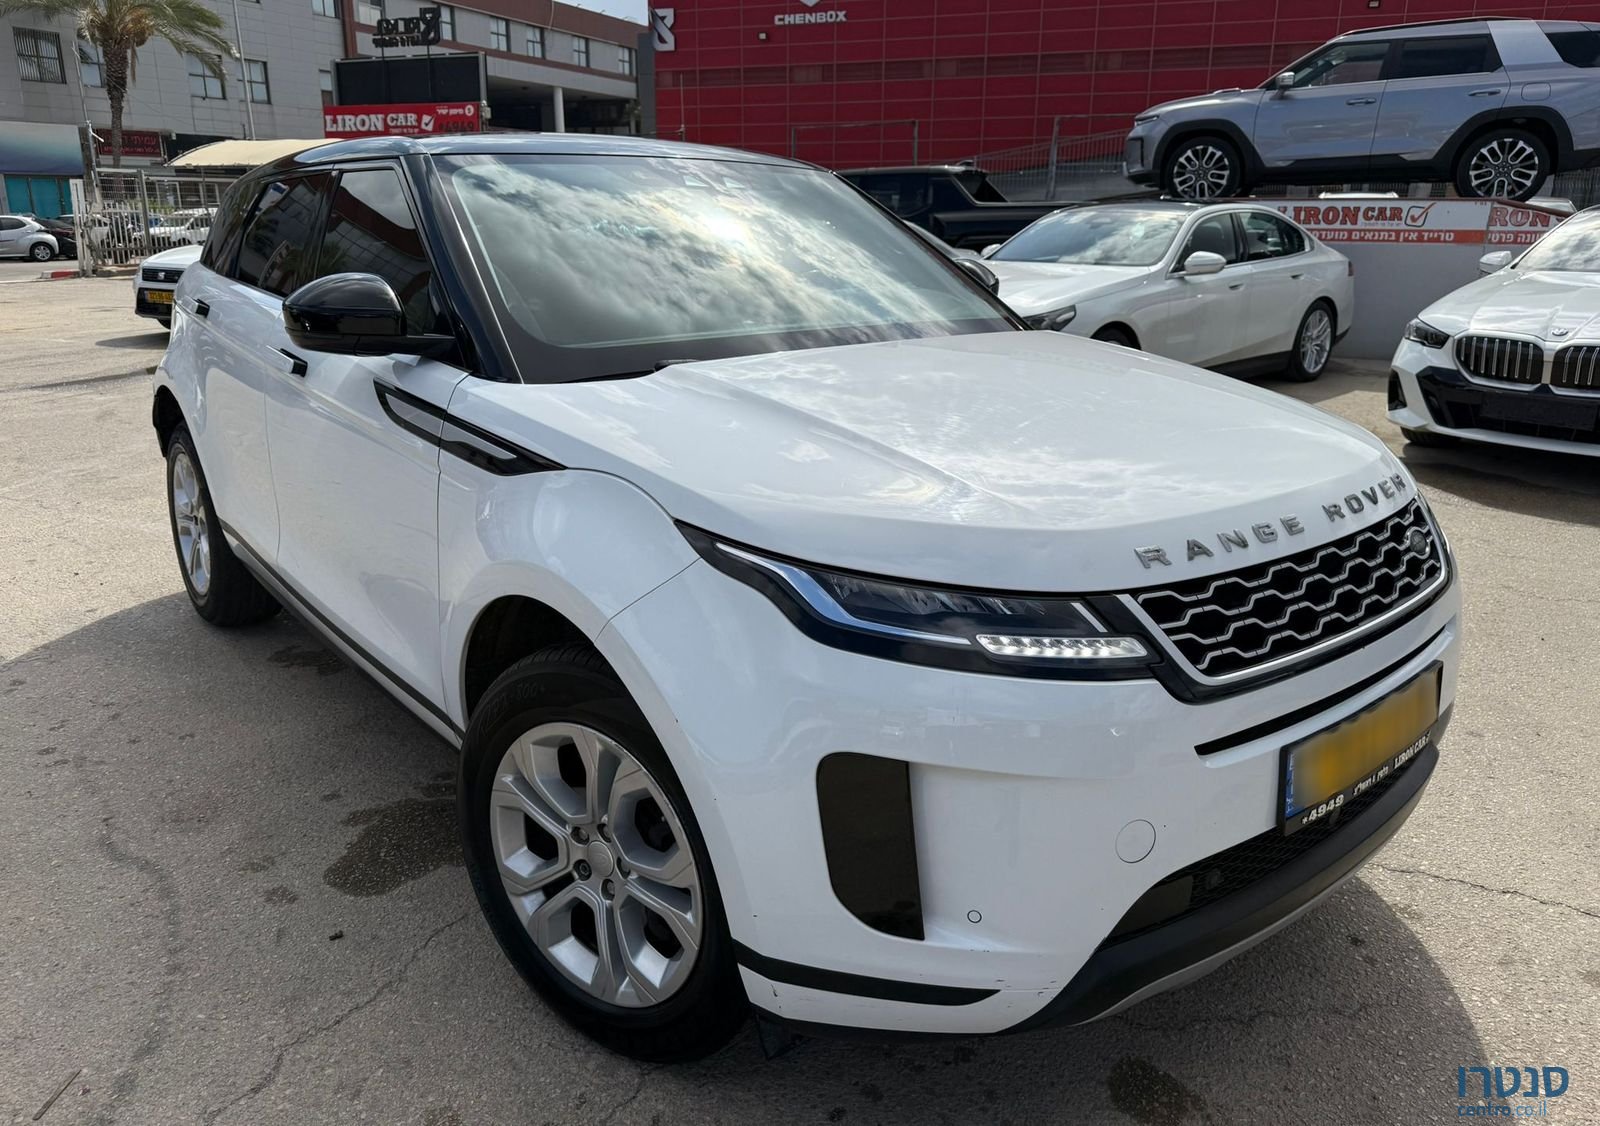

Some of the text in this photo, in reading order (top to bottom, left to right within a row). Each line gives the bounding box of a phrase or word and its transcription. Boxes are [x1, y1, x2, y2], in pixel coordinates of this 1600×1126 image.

[774, 10, 847, 25] CHENBOX
[325, 113, 418, 132] LIRON CAR
[1363, 206, 1403, 222] CAR
[1351, 231, 1396, 241] בתנאים
[1399, 230, 1418, 242] אין
[1422, 231, 1455, 241] טרייד
[1134, 472, 1406, 569] RANGE ROVER
